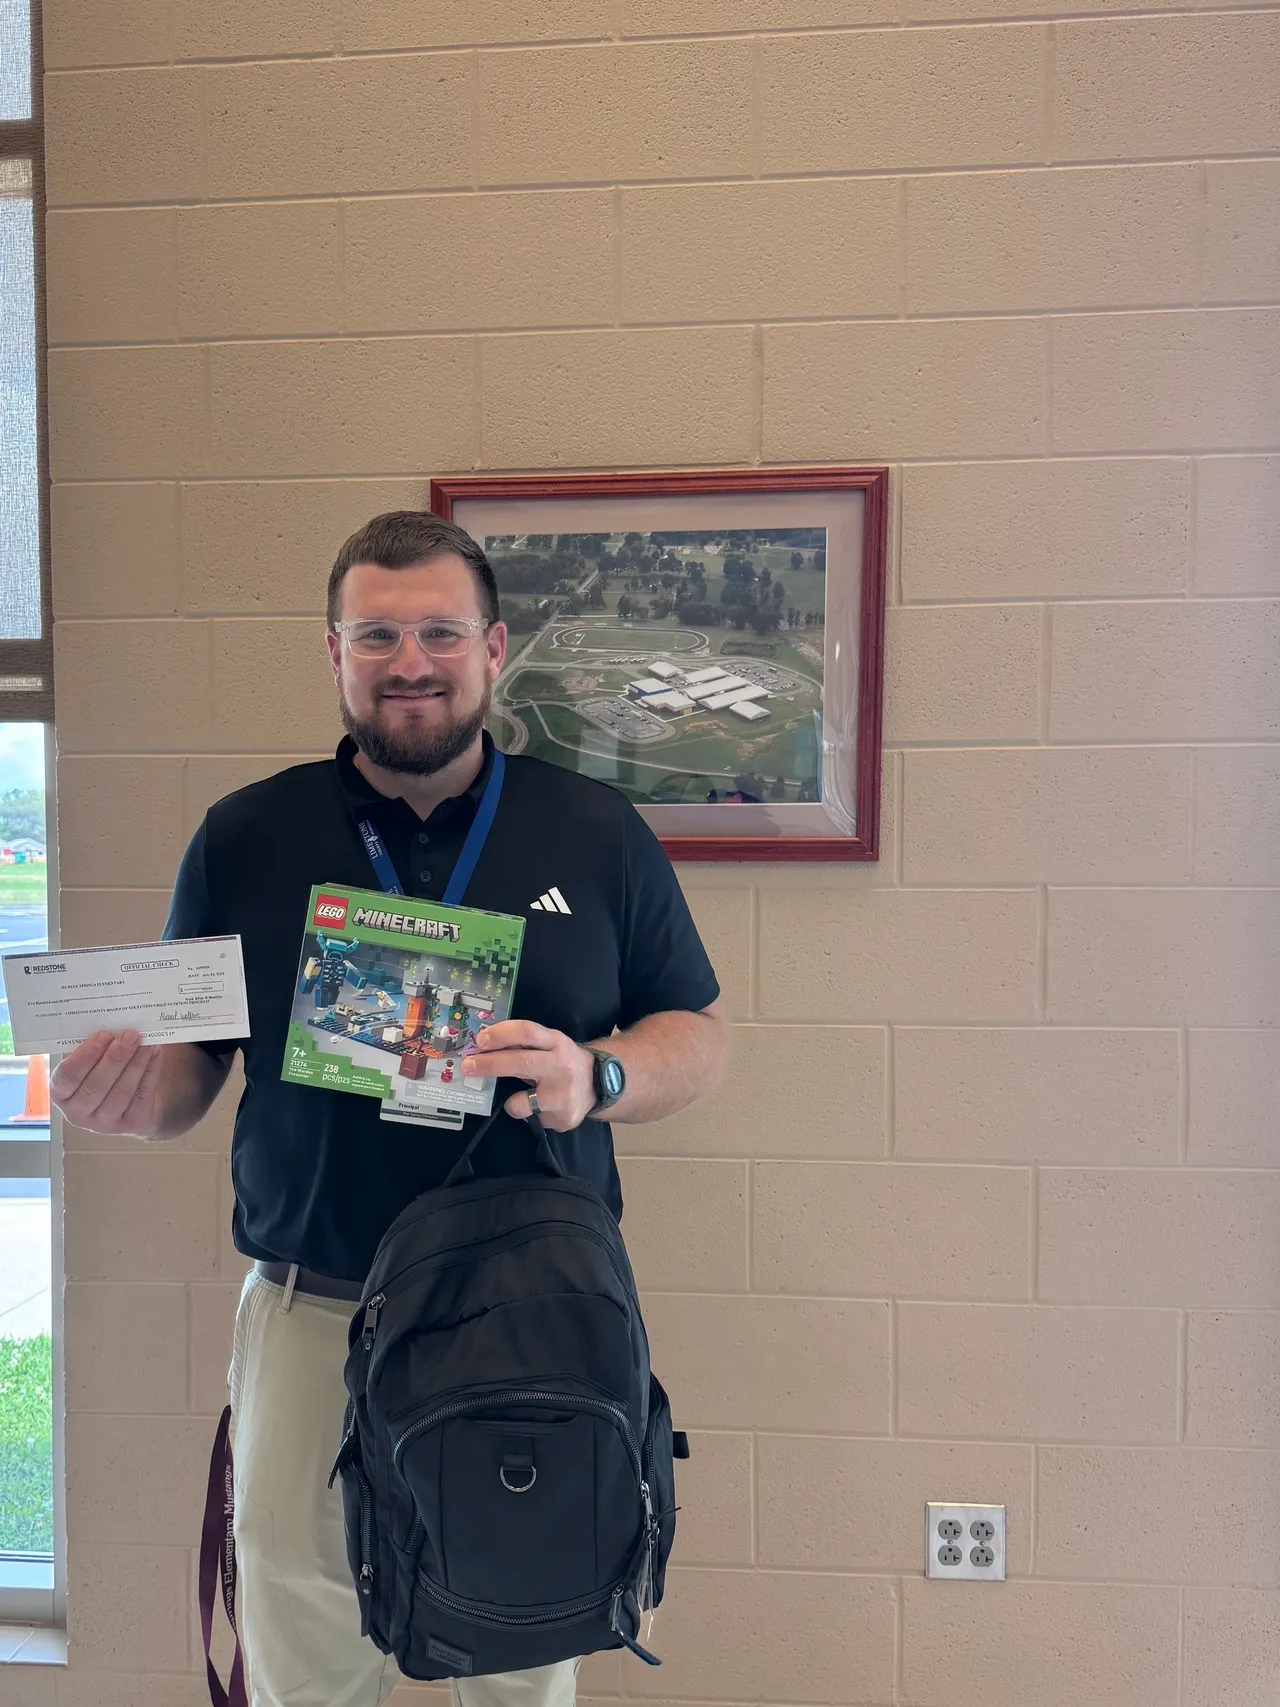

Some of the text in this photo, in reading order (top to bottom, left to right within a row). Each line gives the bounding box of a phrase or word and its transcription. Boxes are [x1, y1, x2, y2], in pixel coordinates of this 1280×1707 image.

[317, 903, 346, 919] LEGO
[352, 907, 462, 943] MINECRAFT
[291, 1046, 307, 1058] 7+
[290, 1059, 308, 1068] 21274
[324, 1063, 339, 1073] 238
[322, 1073, 351, 1084] pcs/pzs
[398, 1102, 420, 1110] Principal
[223, 1464, 233, 1516] Mustangs
[223, 1518, 235, 1585] Elementary
